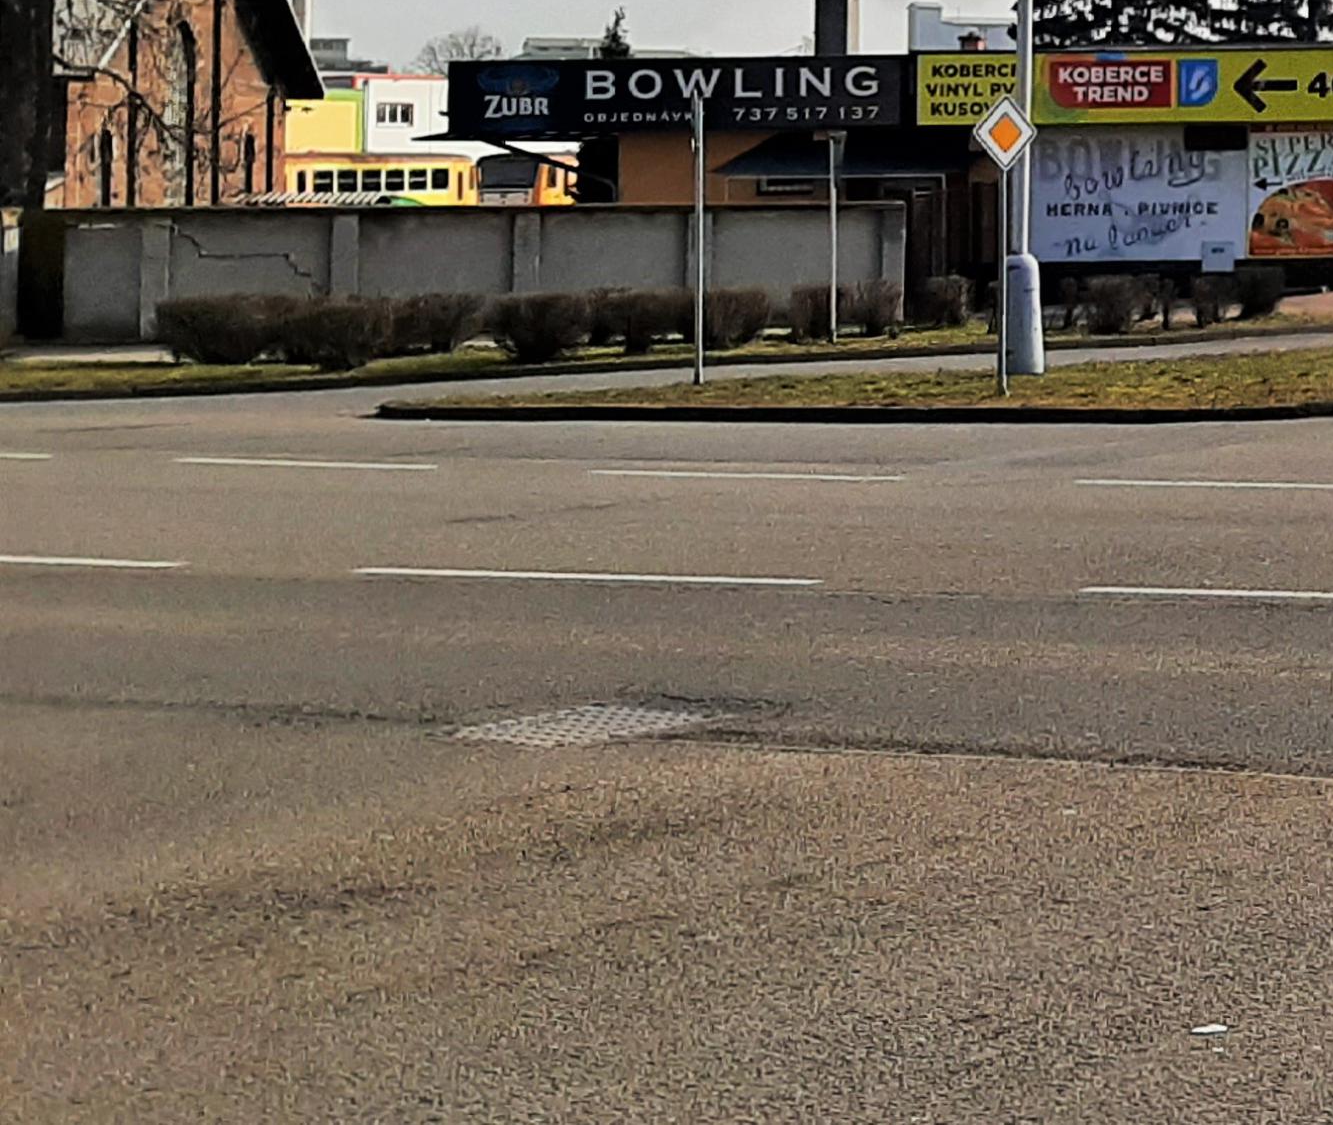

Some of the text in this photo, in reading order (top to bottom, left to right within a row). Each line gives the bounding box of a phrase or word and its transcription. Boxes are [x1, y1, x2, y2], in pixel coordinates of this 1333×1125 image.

[584, 65, 880, 100] BOWLING
[1058, 65, 1164, 84] KOBERCE
[925, 82, 984, 97] VINYL
[1072, 85, 1150, 103] TREND
[483, 95, 549, 118] ZUBR
[583, 106, 880, 123] OBJEDNÁVK 737 517 137
[1046, 203, 1113, 217] HERNA
